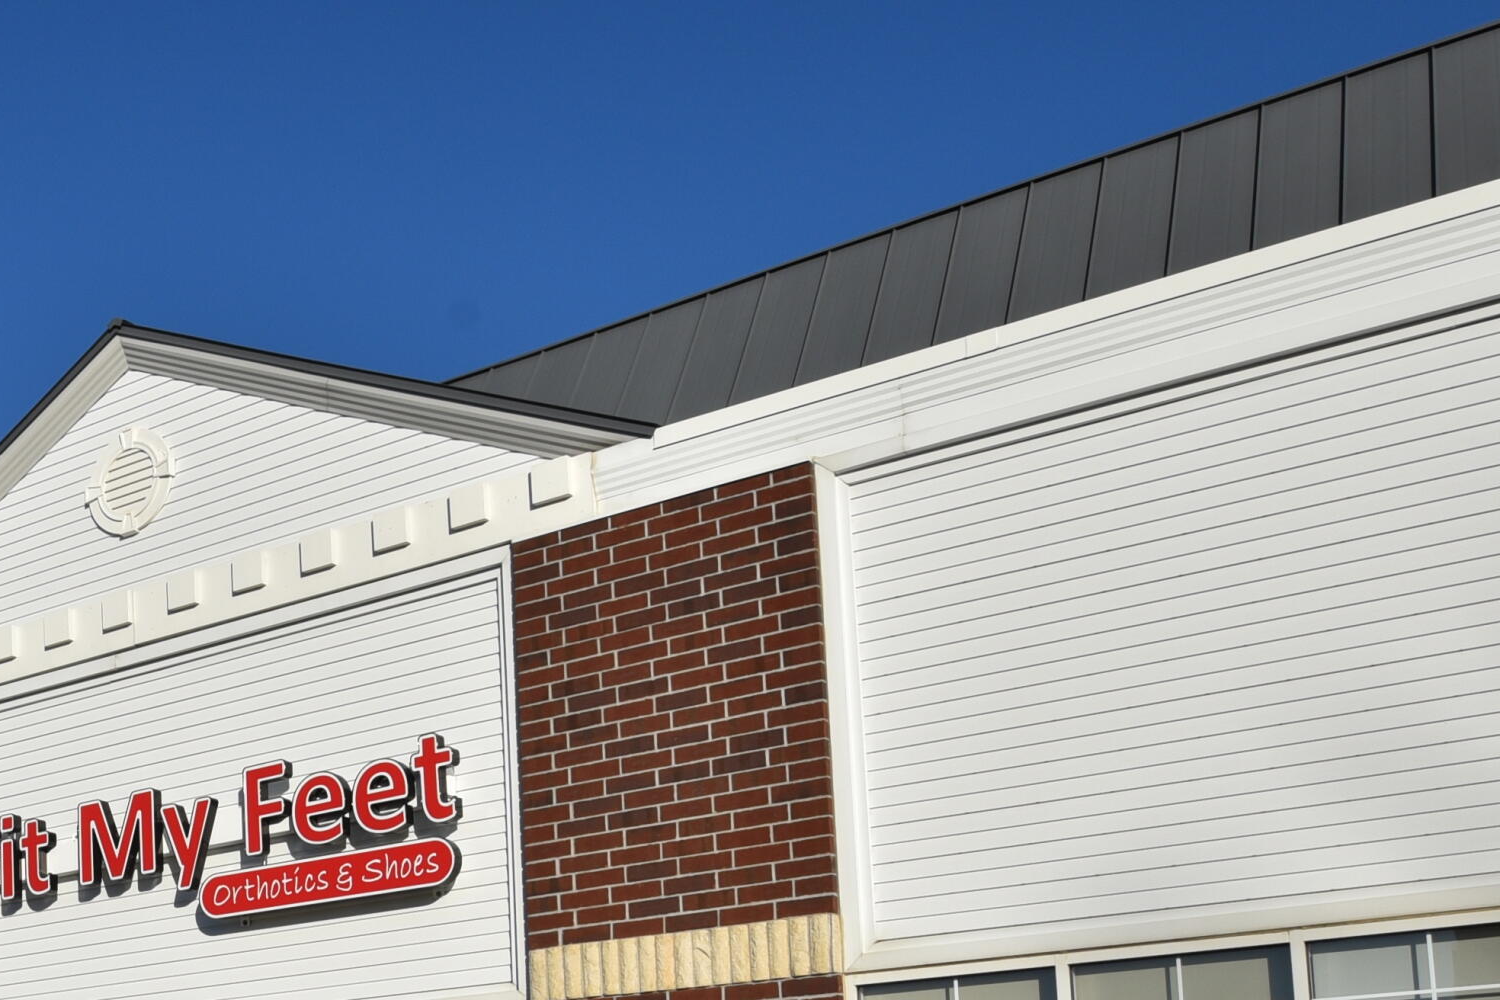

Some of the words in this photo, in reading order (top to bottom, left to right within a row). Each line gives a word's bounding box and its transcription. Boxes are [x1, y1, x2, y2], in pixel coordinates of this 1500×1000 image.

[77, 787, 213, 891] My
[241, 733, 458, 857] Feet
[213, 866, 329, 907] Orthotics
[336, 863, 354, 892] &
[361, 852, 441, 883] Shoes
